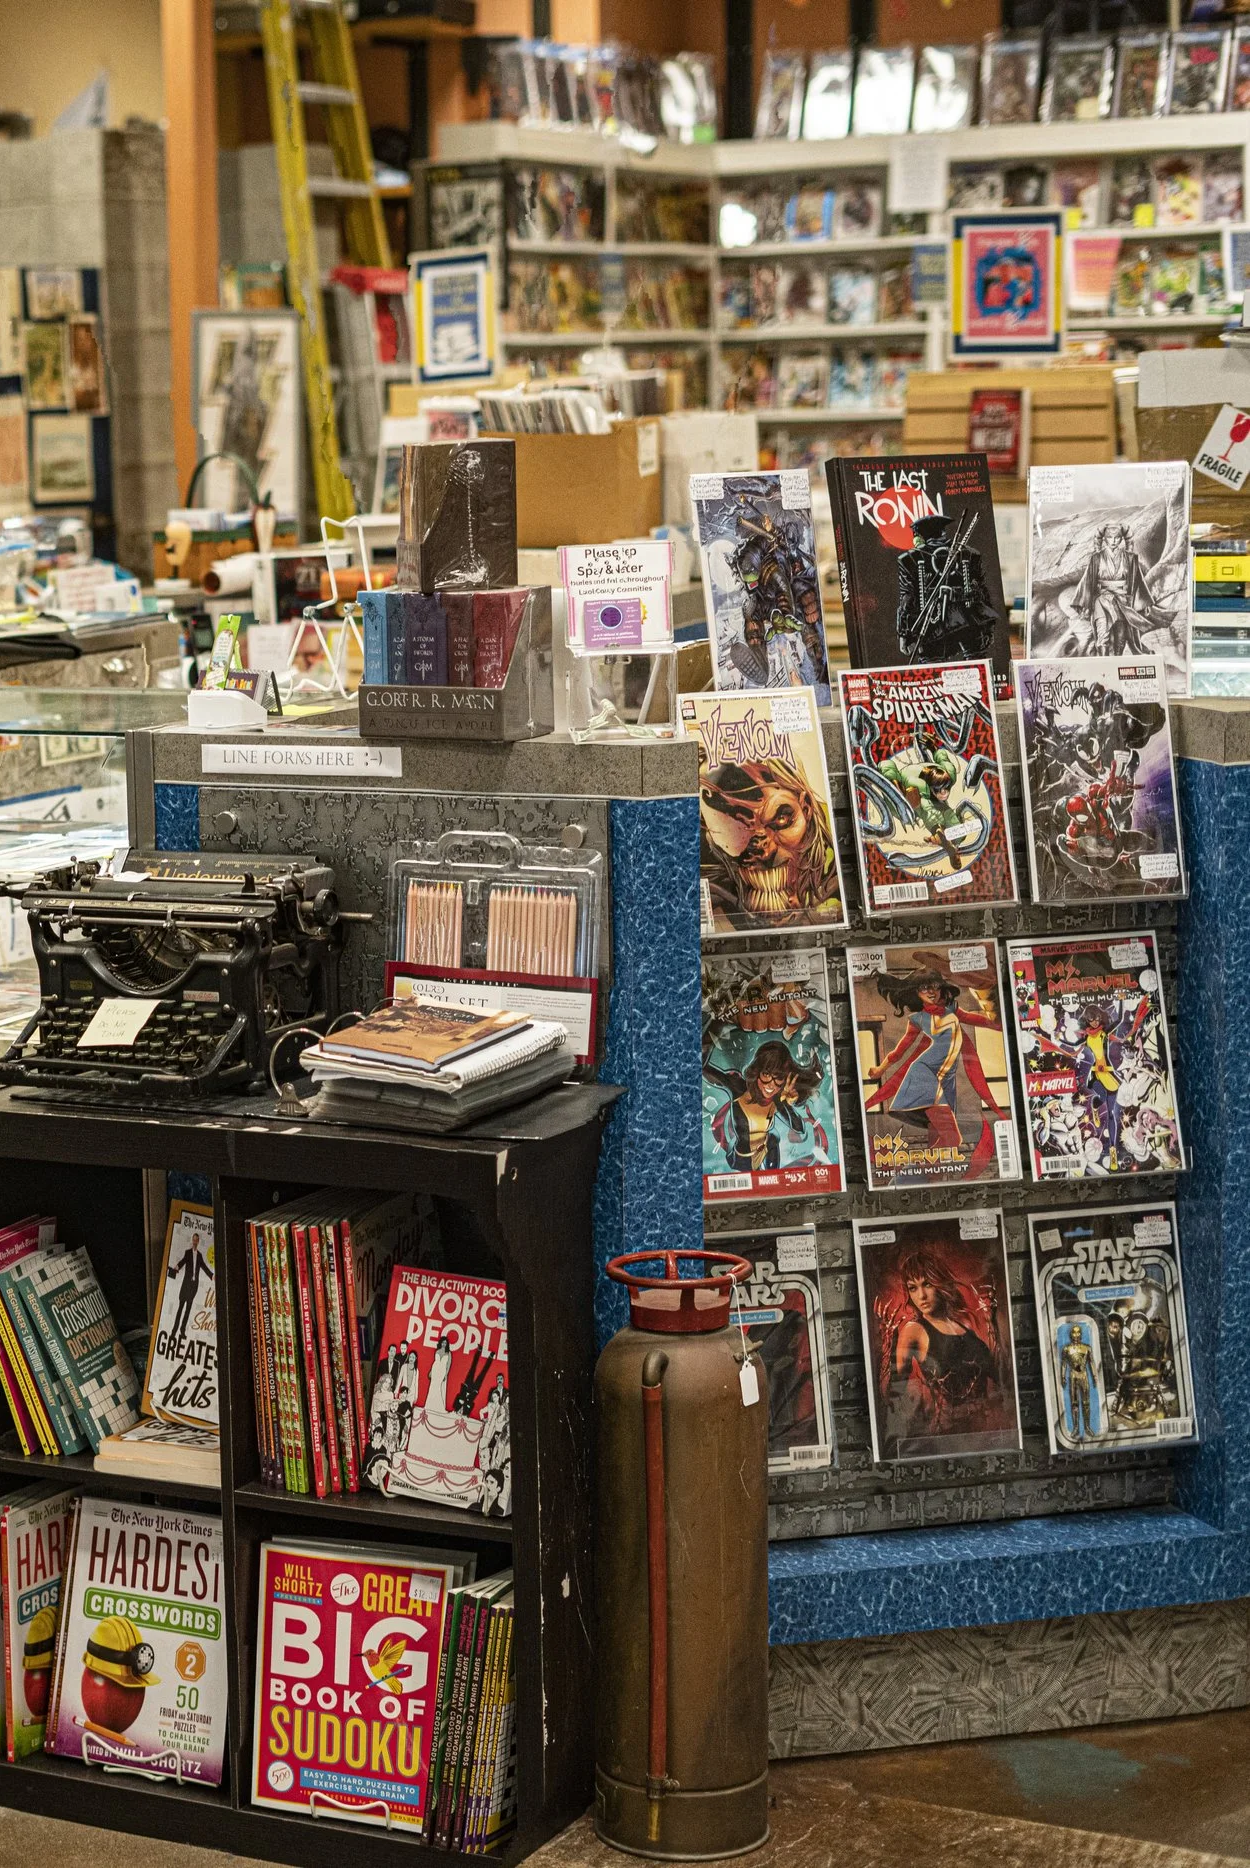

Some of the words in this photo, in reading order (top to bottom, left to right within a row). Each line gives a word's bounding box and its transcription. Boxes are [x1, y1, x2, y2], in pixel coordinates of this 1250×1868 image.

[859, 471, 886, 492] THE
[893, 469, 928, 492] LAST
[1199, 453, 1243, 484] FRAGILE
[855, 490, 943, 528] RONIN
[606, 565, 613, 574] &
[841, 570, 849, 603] RONIN
[849, 680, 868, 688] MARVEL
[1024, 670, 1091, 715] VENOM
[412, 695, 425, 708] R.
[432, 695, 445, 708] R.
[872, 692, 982, 723] SPIDER-MAN
[700, 704, 797, 770] VENOM
[223, 750, 258, 764] LINE
[316, 753, 355, 766] HERE
[1040, 946, 1069, 954] MARVEL
[1045, 955, 1080, 980] MS.
[1048, 973, 1138, 995] MARVEL
[718, 1006, 739, 1022] THE
[744, 1004, 768, 1015] NEW
[768, 989, 817, 1003] MUTANT
[1072, 995, 1095, 1005] NEW
[1022, 1020, 1038, 1028] MARVEL
[1042, 1076, 1075, 1091] MARVEL
[873, 1126, 908, 1153] MS.
[875, 1146, 966, 1168] MARVEL
[758, 1175, 779, 1186] MARVEL
[876, 1170, 896, 1178] THE
[900, 1167, 922, 1176] NEW
[924, 1164, 969, 1174] MUTANT
[184, 1216, 196, 1229] The
[195, 1218, 208, 1233] New
[1073, 1237, 1136, 1263] STAR
[402, 1271, 419, 1285] THE
[421, 1274, 437, 1288] BIG
[437, 1278, 481, 1295] ACTIVITY
[1068, 1259, 1146, 1285] WARS
[260, 1287, 268, 1311] SUPER
[394, 1282, 507, 1330] DIVORC
[716, 1284, 786, 1308] ARS
[303, 1310, 309, 1321] MY
[263, 1313, 271, 1347] SUNDAY
[406, 1317, 509, 1362] PEOPLE
[6, 1288, 28, 1335] BEGINNER'S
[22, 1335, 43, 1372] CROSSWORD
[38, 1373, 56, 1407] DICTIONARY
[27, 1293, 52, 1340] BEGINNER'S
[47, 1339, 70, 1376] CROSSWORD
[64, 1376, 84, 1410] DICTIONARY
[306, 1343, 312, 1351] IS
[265, 1347, 276, 1399] CROSSWORDS
[159, 1364, 217, 1409] hits
[309, 1378, 317, 1420] CROSSWORD
[312, 1422, 320, 1452] PUZZLES
[111, 1508, 131, 1526] The
[131, 1510, 154, 1528] New
[155, 1514, 181, 1534] York
[181, 1516, 213, 1537] Times
[285, 1563, 313, 1581] WILL
[274, 1576, 323, 1597] SHORTZ
[332, 1579, 358, 1598] The
[90, 1594, 216, 1633] CROSSWORDS
[270, 1601, 429, 1694] BIG
[185, 1654, 196, 1676] 2
[454, 1653, 462, 1676] SUPER
[460, 1656, 469, 1680] SUPER
[472, 1657, 480, 1680] SUPER
[436, 1678, 444, 1709] SUNDAY
[450, 1678, 459, 1709] SUNDAY
[480, 1670, 488, 1695] VARIETY
[176, 1685, 199, 1710] 50
[270, 1678, 362, 1715] BOOK
[379, 1696, 426, 1721] OF
[457, 1681, 465, 1712] SUNDAY
[468, 1682, 477, 1713] SUNDAY
[160, 1707, 178, 1718] FRIDAY
[186, 1712, 212, 1725] SATURDAY
[174, 1721, 196, 1733] PUZZLES
[158, 1729, 166, 1737] TO
[170, 1731, 210, 1746] CHALLENGE
[162, 1740, 181, 1749] YOUR
[184, 1743, 205, 1753] BRAIN
[269, 1705, 423, 1778] SUDOKU
[430, 1710, 440, 1761] CROSSWORDS
[444, 1710, 455, 1762] CROSSWORDS
[450, 1714, 461, 1765] CROSSWORDS
[462, 1714, 473, 1766] CROSSWORDS
[473, 1713, 482, 1760] EXTRAVAGANZA
[481, 1713, 491, 1760] EXTRAVAGANZA
[490, 1713, 500, 1760] EXTRAVAGANZA
[85, 1744, 103, 1756] DITED
[271, 1766, 291, 1785] 500
[304, 1771, 324, 1779] EASY
[340, 1776, 363, 1785] HARD
[366, 1780, 401, 1791] PUZZLES
[404, 1786, 416, 1794] TO
[313, 1780, 352, 1791] EXERCISE
[356, 1786, 377, 1796] YOUR
[380, 1790, 405, 1800] BRAIN
